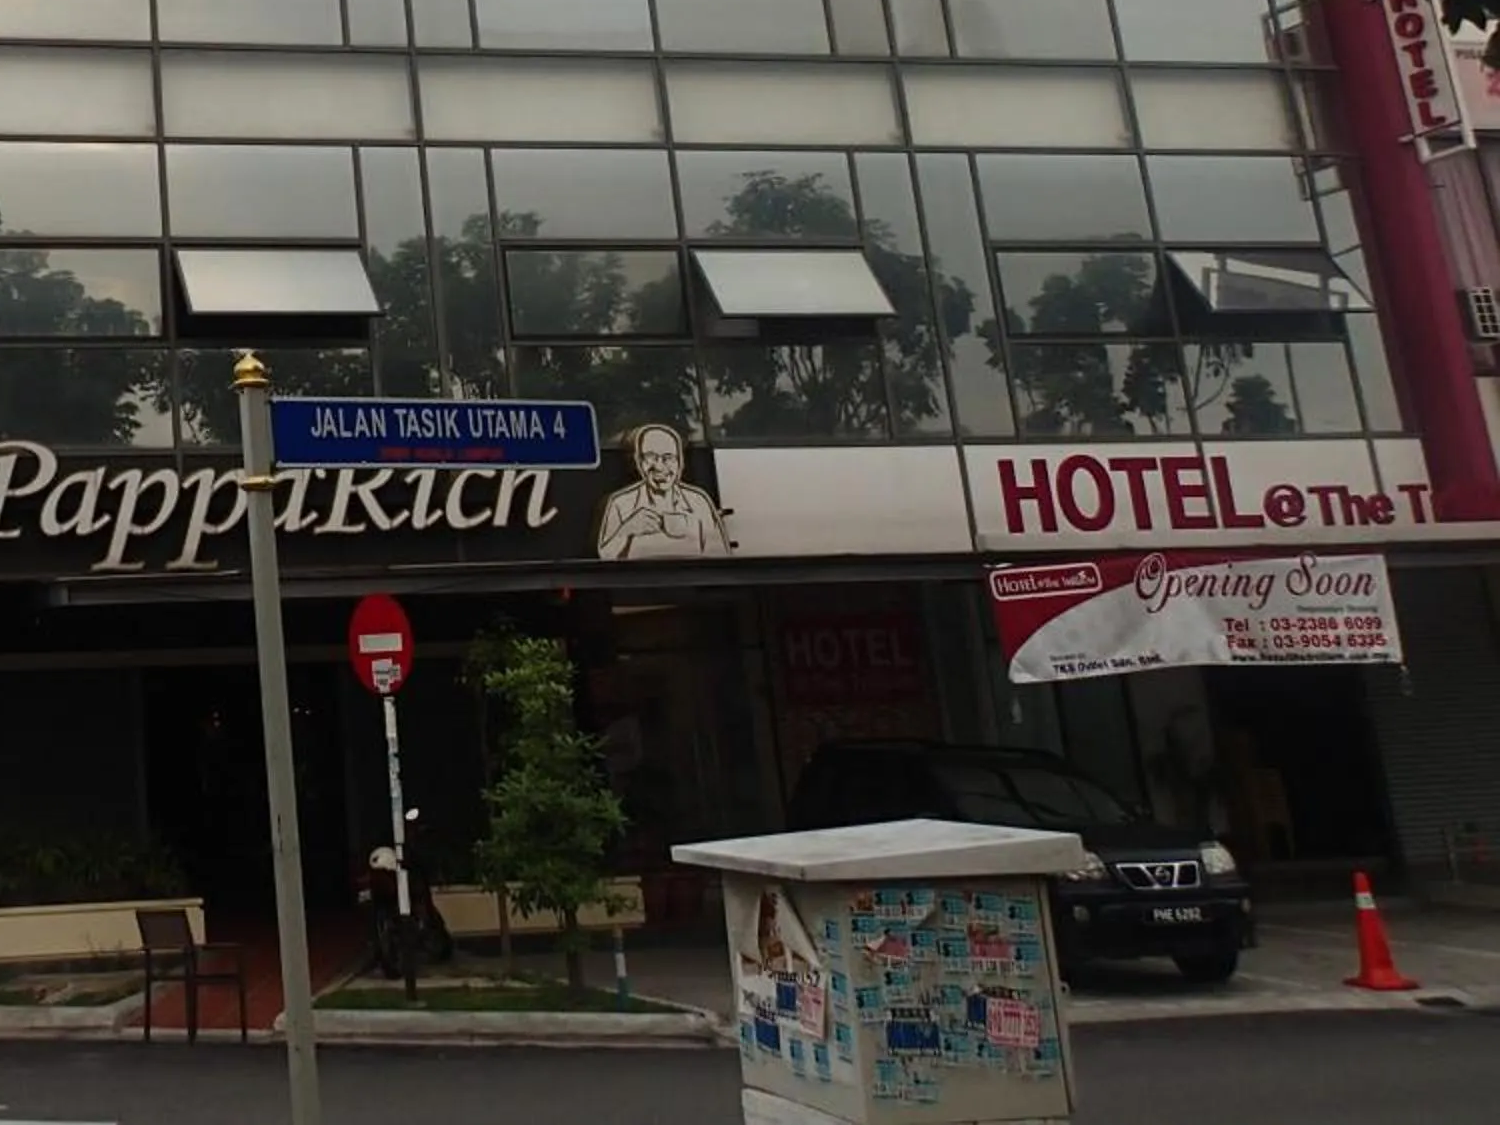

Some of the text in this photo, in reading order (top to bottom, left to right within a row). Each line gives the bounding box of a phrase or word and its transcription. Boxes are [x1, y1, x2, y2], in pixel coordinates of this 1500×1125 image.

[311, 407, 565, 440] JALAN TASIK UTAMA 4
[1135, 550, 1374, 614] Opening Soon
[1224, 618, 1249, 632] Tel
[785, 627, 913, 669] HOTEL
[1227, 635, 1256, 649] Fax
